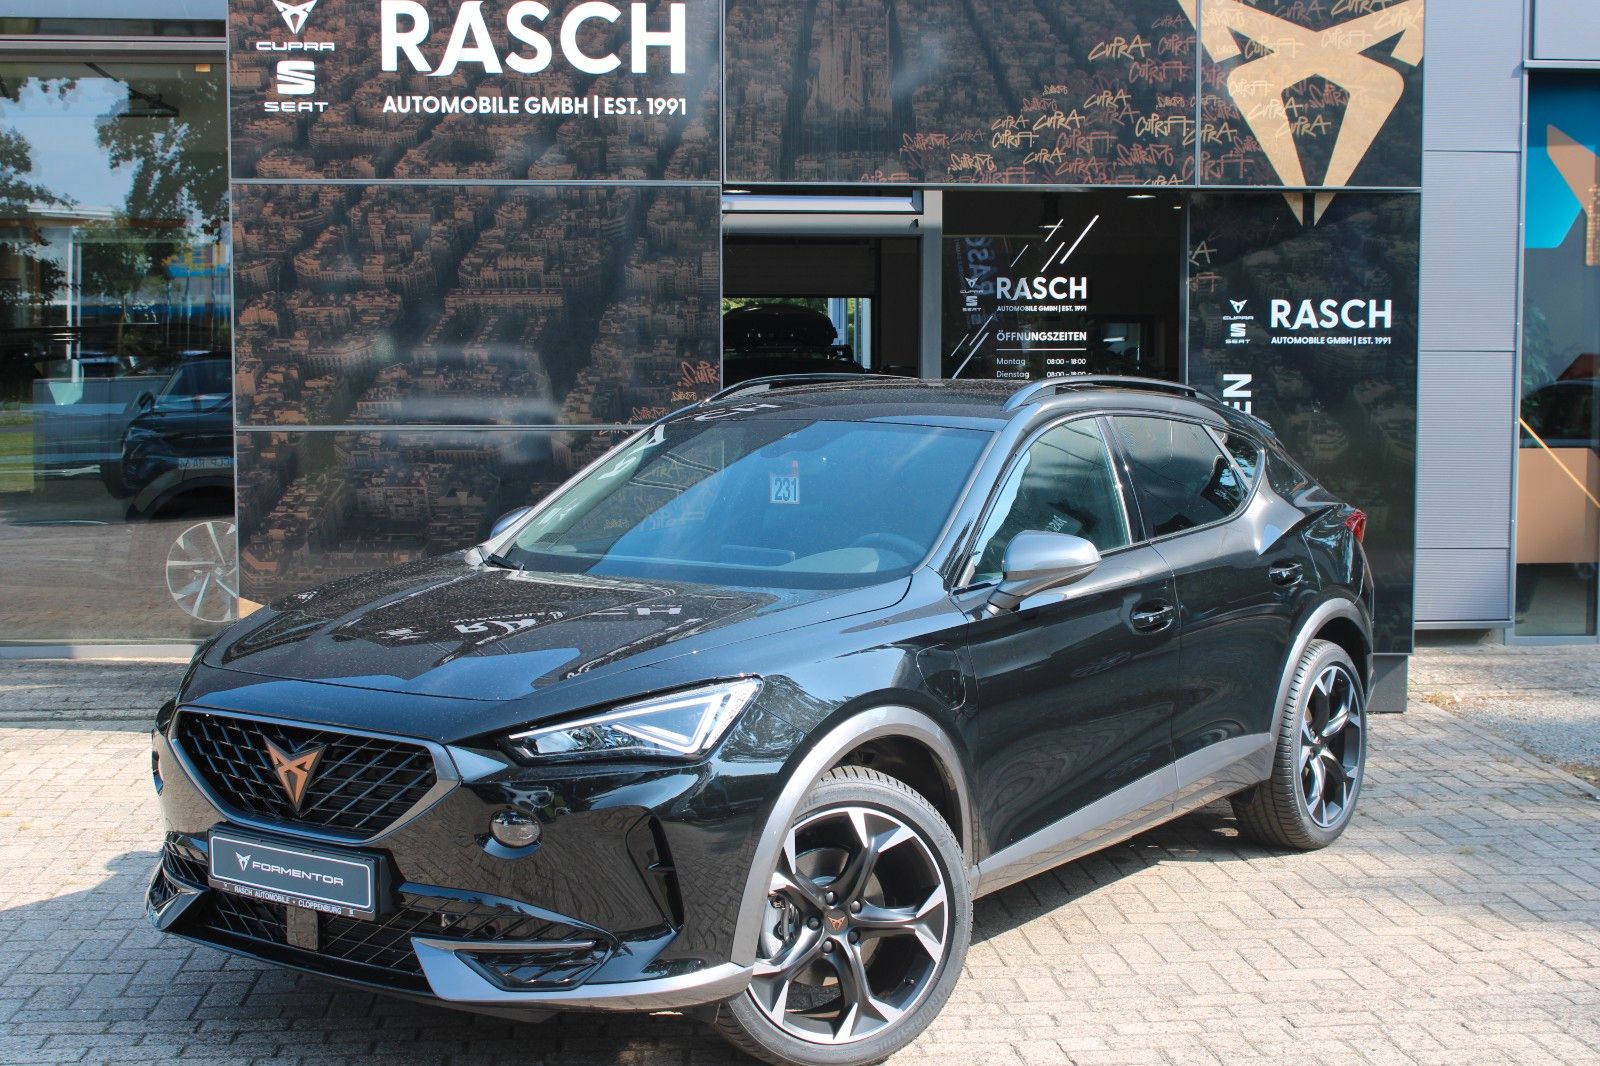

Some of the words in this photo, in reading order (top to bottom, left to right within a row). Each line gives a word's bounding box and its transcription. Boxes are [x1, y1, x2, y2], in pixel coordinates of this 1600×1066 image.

[256, 42, 335, 51] CUPRA
[381, 1, 686, 77] RASCH
[263, 101, 329, 113] SEAT
[382, 95, 520, 114] AUTOMOBILE
[524, 96, 588, 115] GMBH
[604, 97, 642, 115] EST.
[646, 98, 687, 116] 1991
[996, 276, 1087, 301] RASCH
[1271, 298, 1392, 330] RASCH
[996, 329, 1087, 342] ÖFFNUNGSZEITEN
[1270, 336, 1326, 345] AUTOMOBILE
[1326, 336, 1352, 345] GMBH
[1358, 336, 1373, 345] EST.
[1375, 336, 1392, 345] 1991
[996, 358, 1026, 367] Montag
[996, 370, 1030, 380] Dienstag
[774, 477, 798, 502] 231
[252, 861, 344, 886] FORMENTOR
[234, 885, 253, 896] RASCH
[254, 890, 290, 904] AUTOMOBILE
[298, 900, 342, 915] CLOPPENBURG
